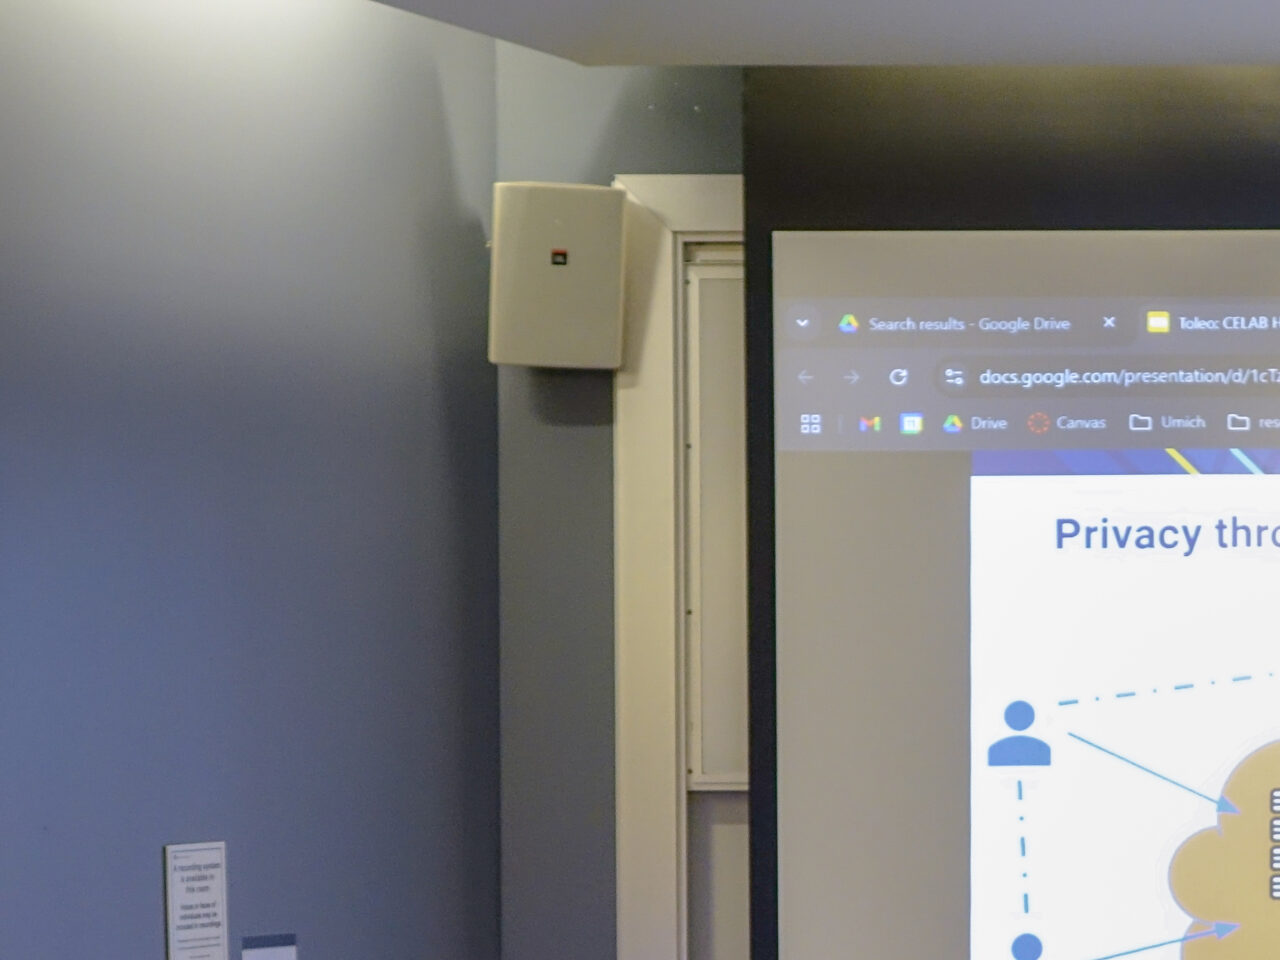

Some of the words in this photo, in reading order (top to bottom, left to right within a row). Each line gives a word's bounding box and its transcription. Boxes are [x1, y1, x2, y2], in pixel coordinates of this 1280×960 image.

[868, 317, 915, 331] Search
[919, 317, 965, 331] results
[978, 317, 1030, 333] Google
[1033, 316, 1071, 330] Drive
[1222, 315, 1268, 329] CELAB
[971, 416, 1008, 430] Drive
[1056, 415, 1106, 429] Canvas
[1161, 415, 1206, 429] Umich
[1055, 517, 1202, 557] Privacy
